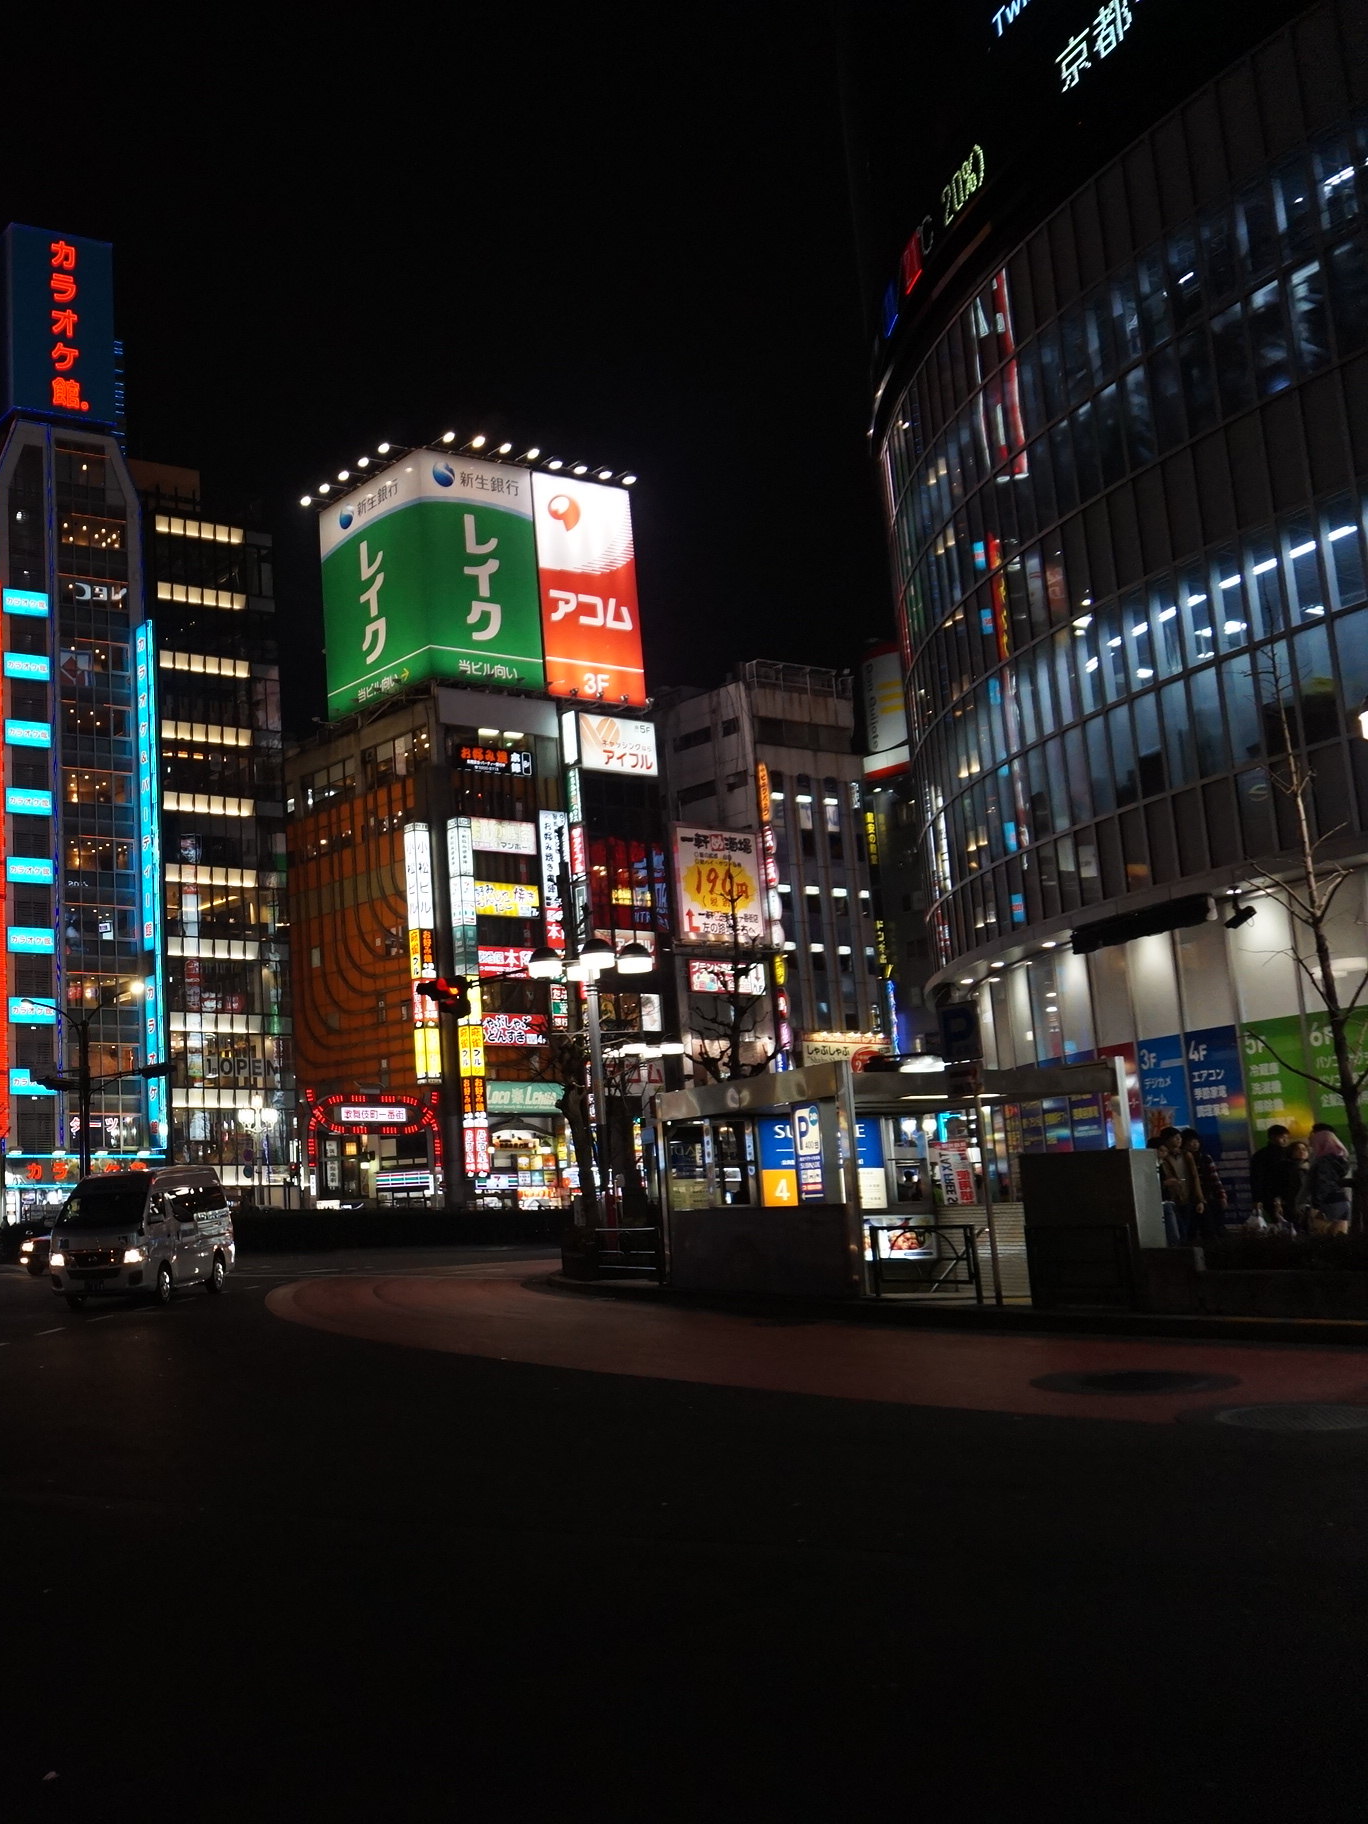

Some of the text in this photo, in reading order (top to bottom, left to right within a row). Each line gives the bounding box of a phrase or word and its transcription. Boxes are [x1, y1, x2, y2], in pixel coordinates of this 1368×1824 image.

[459, 470, 520, 498] 新生銀行
[357, 478, 399, 517] 新生銀行
[463, 513, 502, 641] レイク
[359, 540, 387, 665] レイク
[549, 588, 633, 631] アコム
[583, 673, 610, 695] 3F
[602, 749, 654, 771] アイフル
[1244, 1031, 1267, 1055] 5F
[1309, 1022, 1334, 1047] 6F
[1140, 1049, 1157, 1070] 3F
[1188, 1040, 1208, 1062] 4F
[220, 1058, 279, 1077] OPEN
[1192, 1068, 1225, 1083] エアコン
[1144, 1075, 1172, 1089] デジカメ
[797, 1115, 809, 1150] P
[775, 1178, 791, 1201] 4
